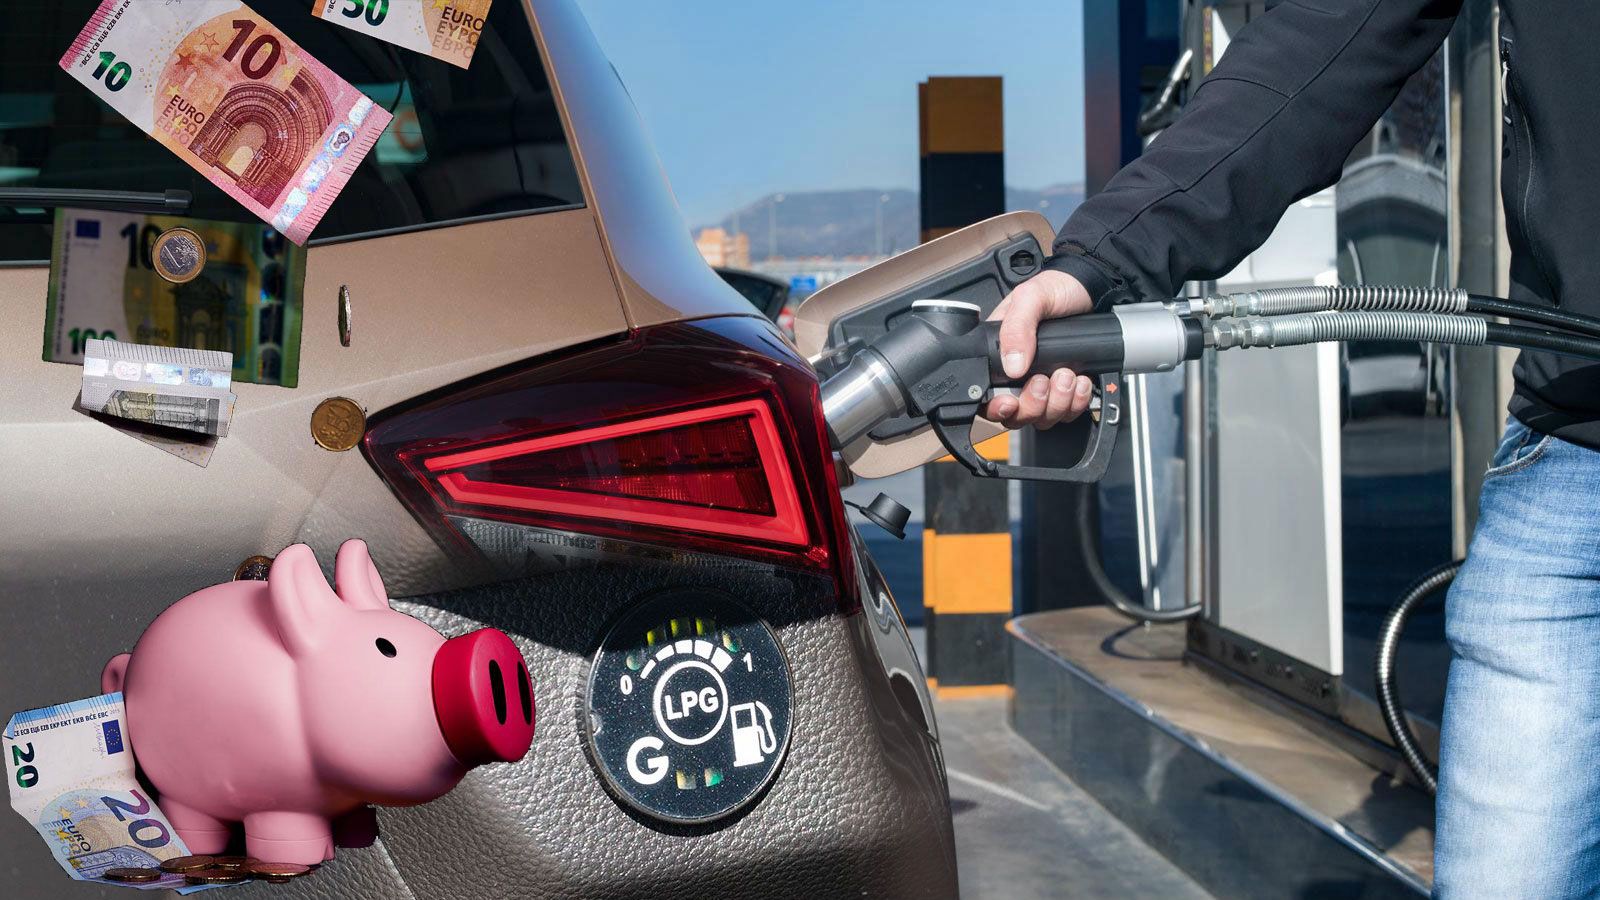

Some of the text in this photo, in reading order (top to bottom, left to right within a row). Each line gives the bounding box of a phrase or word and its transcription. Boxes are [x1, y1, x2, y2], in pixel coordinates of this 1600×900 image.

[90, 42, 100, 54] ECB
[106, 19, 117, 31] EZB
[114, 7, 124, 20] EKP
[441, 6, 485, 31] EURO
[221, 19, 282, 80] 10
[92, 51, 132, 92] 10
[170, 94, 205, 124] EURO
[743, 652, 753, 672] 1
[620, 674, 633, 695] 0
[664, 687, 719, 721] LPG
[20, 728, 30, 736] ECB
[49, 721, 60, 730] EKP
[60, 718, 72, 727] EKT
[72, 715, 85, 725] EKB
[97, 709, 109, 719] EBC
[12, 742, 39, 788] 20
[626, 736, 670, 785] G
[61, 818, 91, 852] EURO
[100, 789, 171, 848] 20
